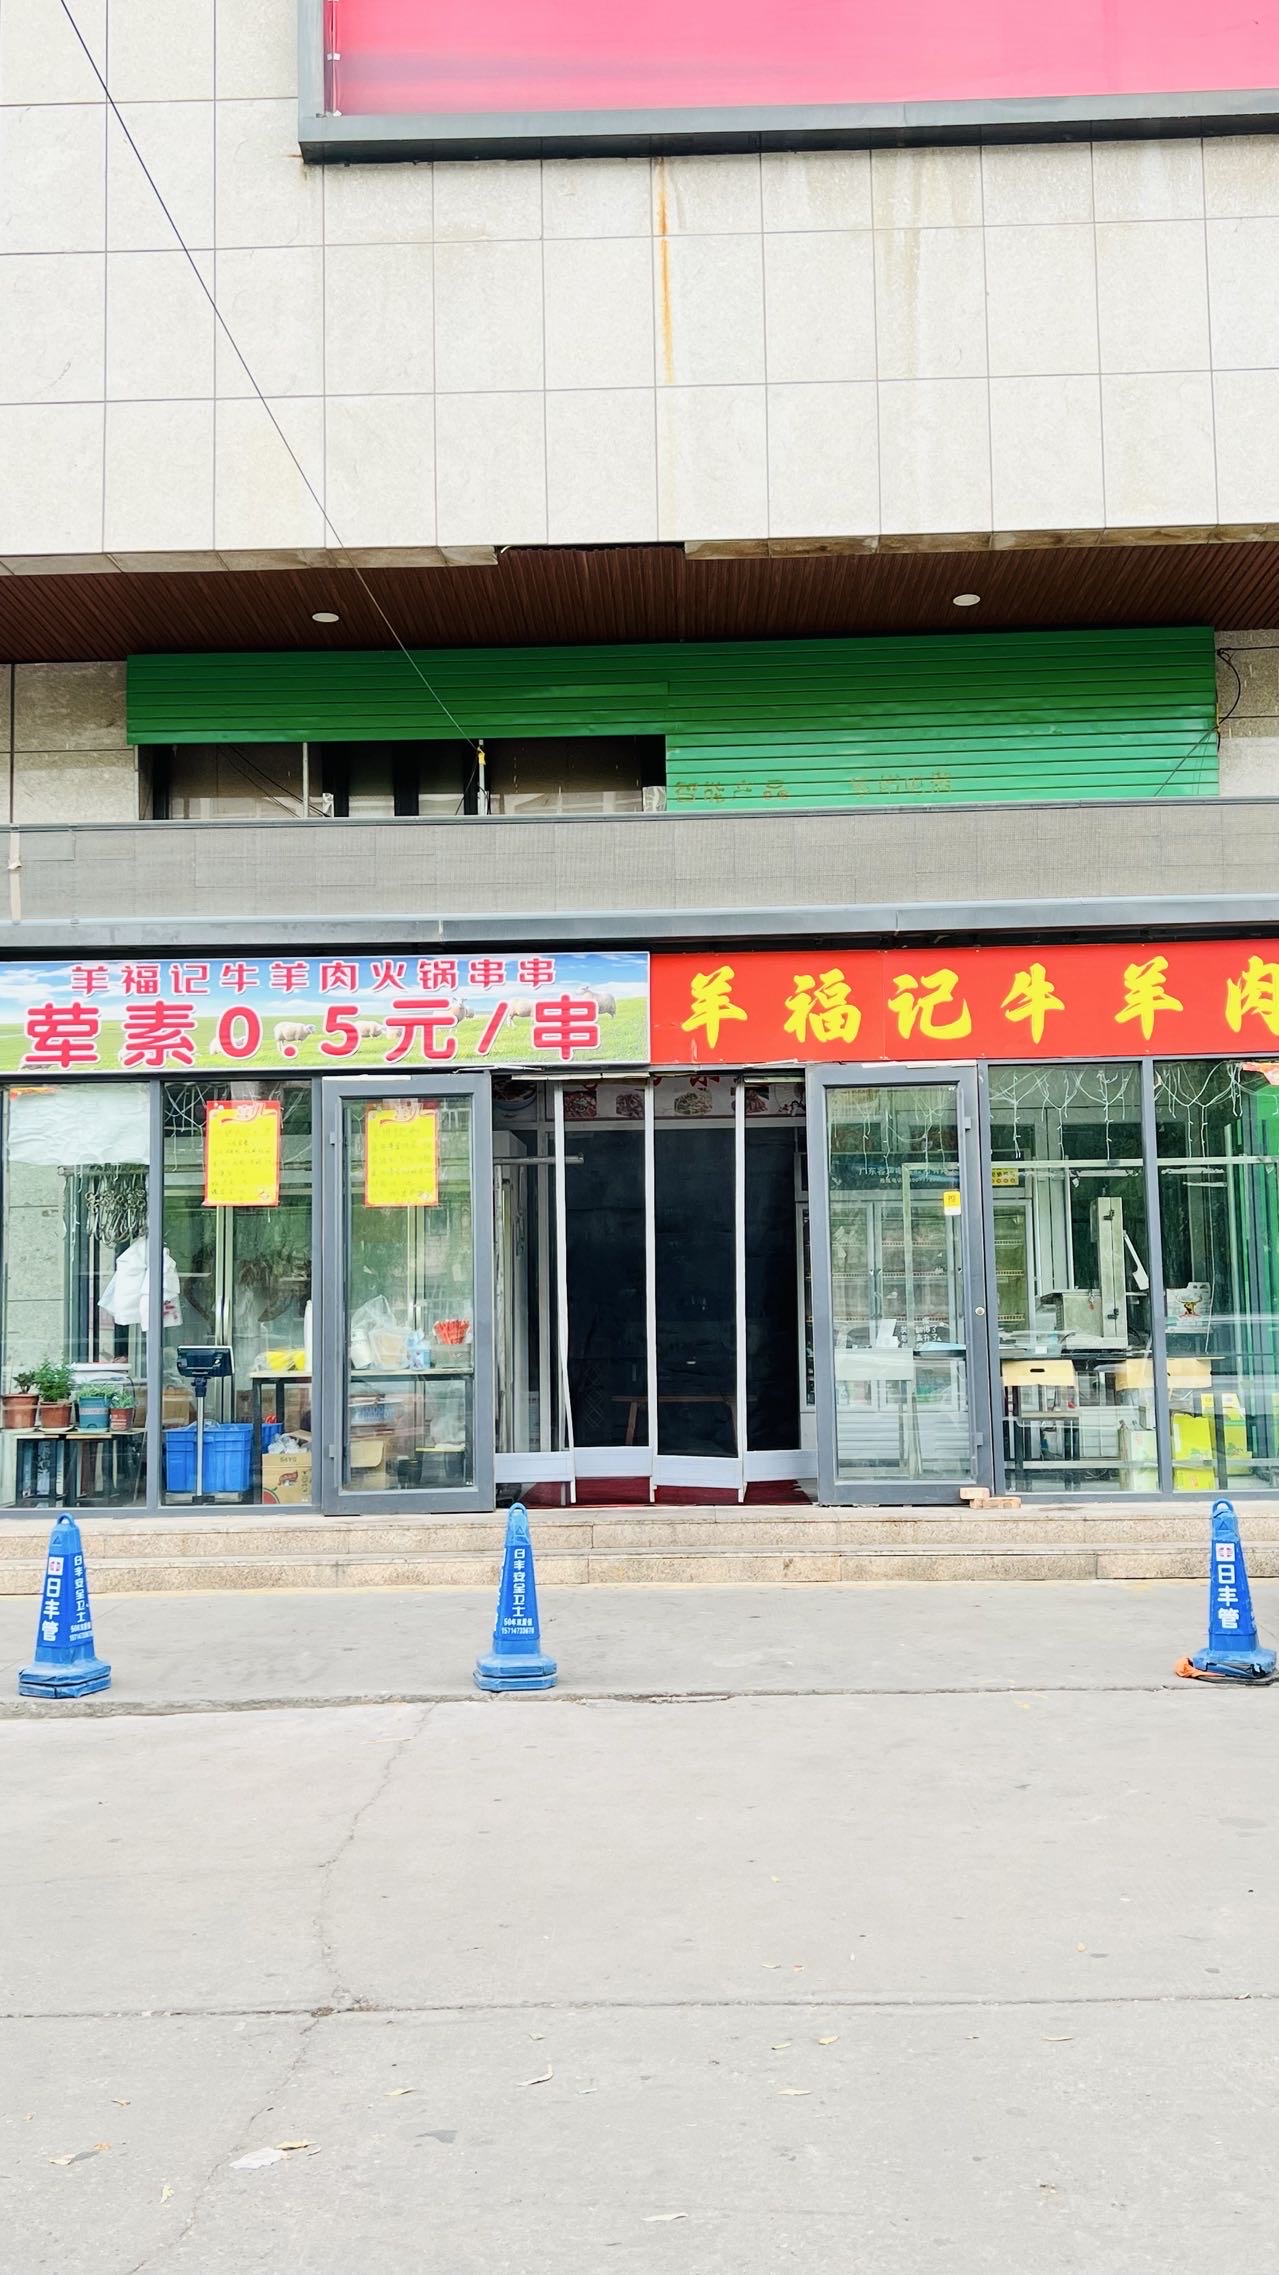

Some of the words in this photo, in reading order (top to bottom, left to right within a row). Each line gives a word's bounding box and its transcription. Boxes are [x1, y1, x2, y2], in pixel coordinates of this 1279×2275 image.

[70, 957, 557, 995] 羊福记牛羊肉火锅串串
[681, 955, 1279, 1049] 羊福记牛羊肉
[24, 993, 601, 1070] 荤素0.5元/串
[42, 1578, 62, 1642] 日丰管
[512, 1548, 526, 1617] 日丰安全卫士
[1217, 1564, 1239, 1629] 日丰管
